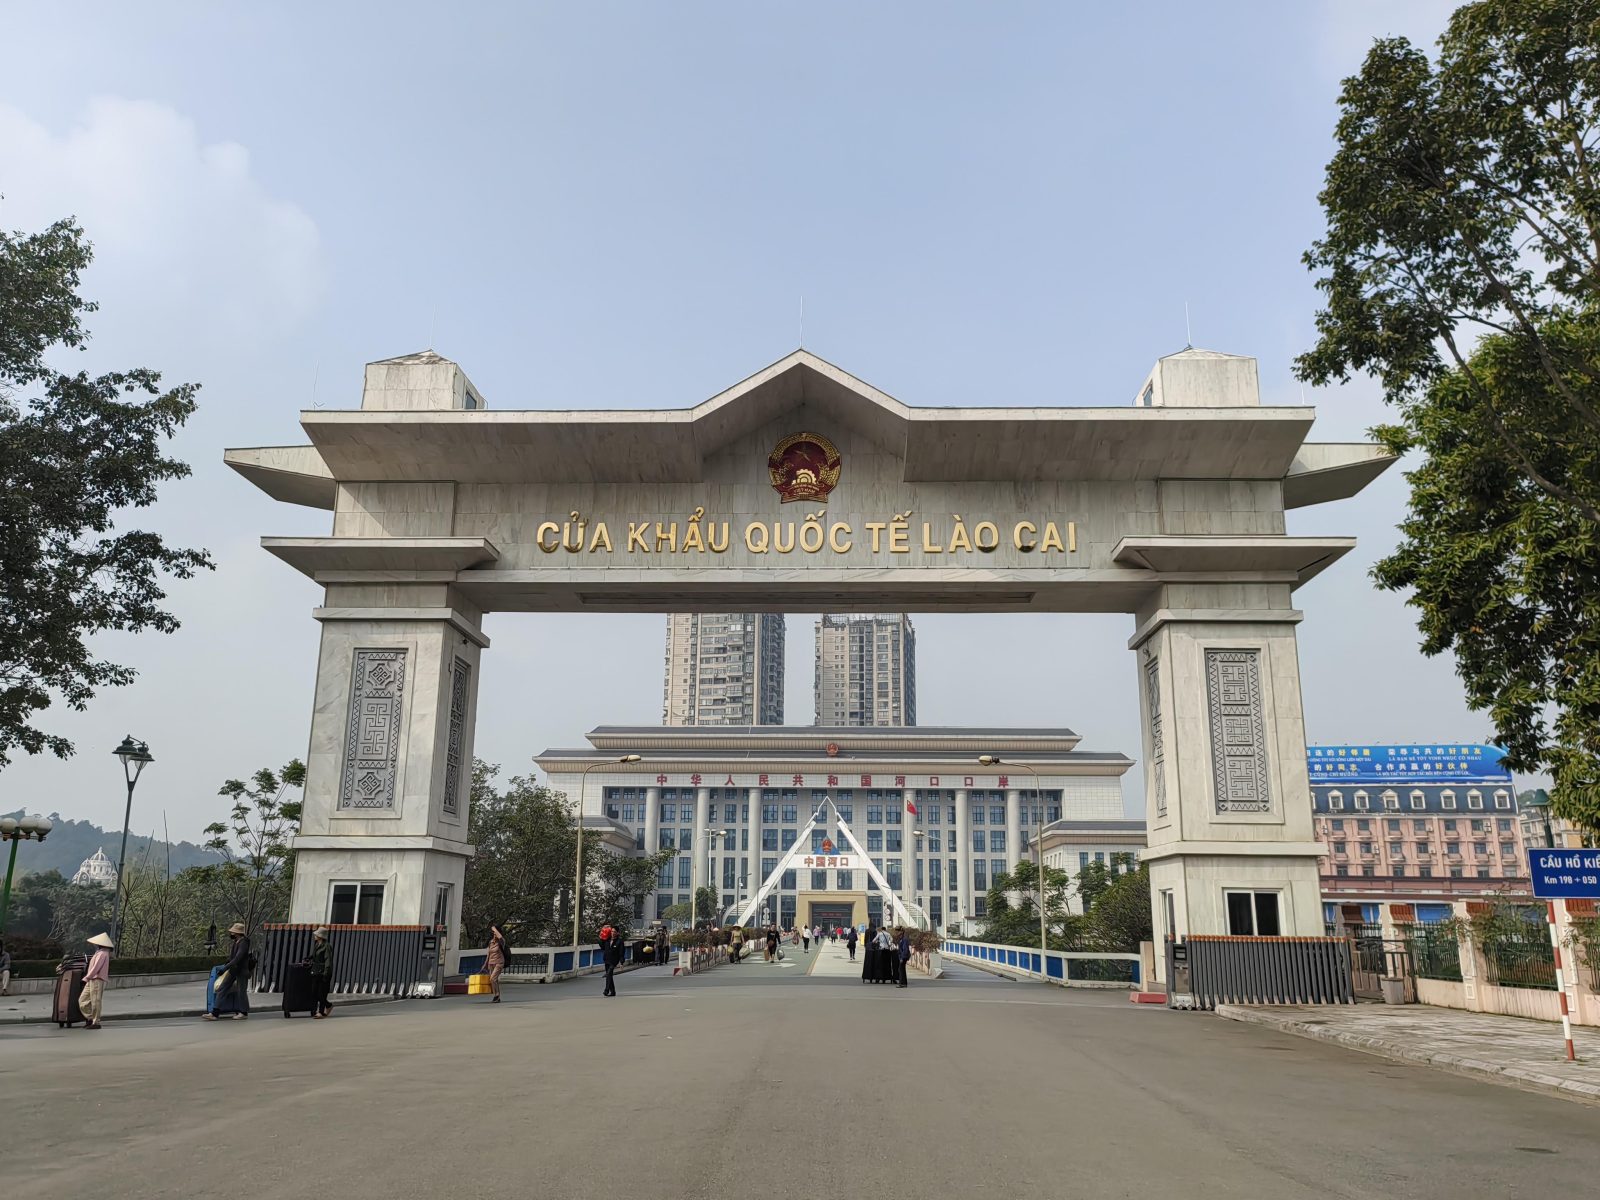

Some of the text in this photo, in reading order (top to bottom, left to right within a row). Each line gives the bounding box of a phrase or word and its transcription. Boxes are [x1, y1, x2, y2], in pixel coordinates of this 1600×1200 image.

[537, 506, 1076, 554] CỬA KHẨU QUỐC TẾ LÀO CAI
[656, 774, 1009, 788] 中华人民共和国河口口岸
[804, 856, 849, 867] 中国河口
[1540, 853, 1562, 868] CẦU
[1544, 875, 1558, 884] Km
[1559, 875, 1573, 884] 198
[1582, 875, 1597, 885] 050
